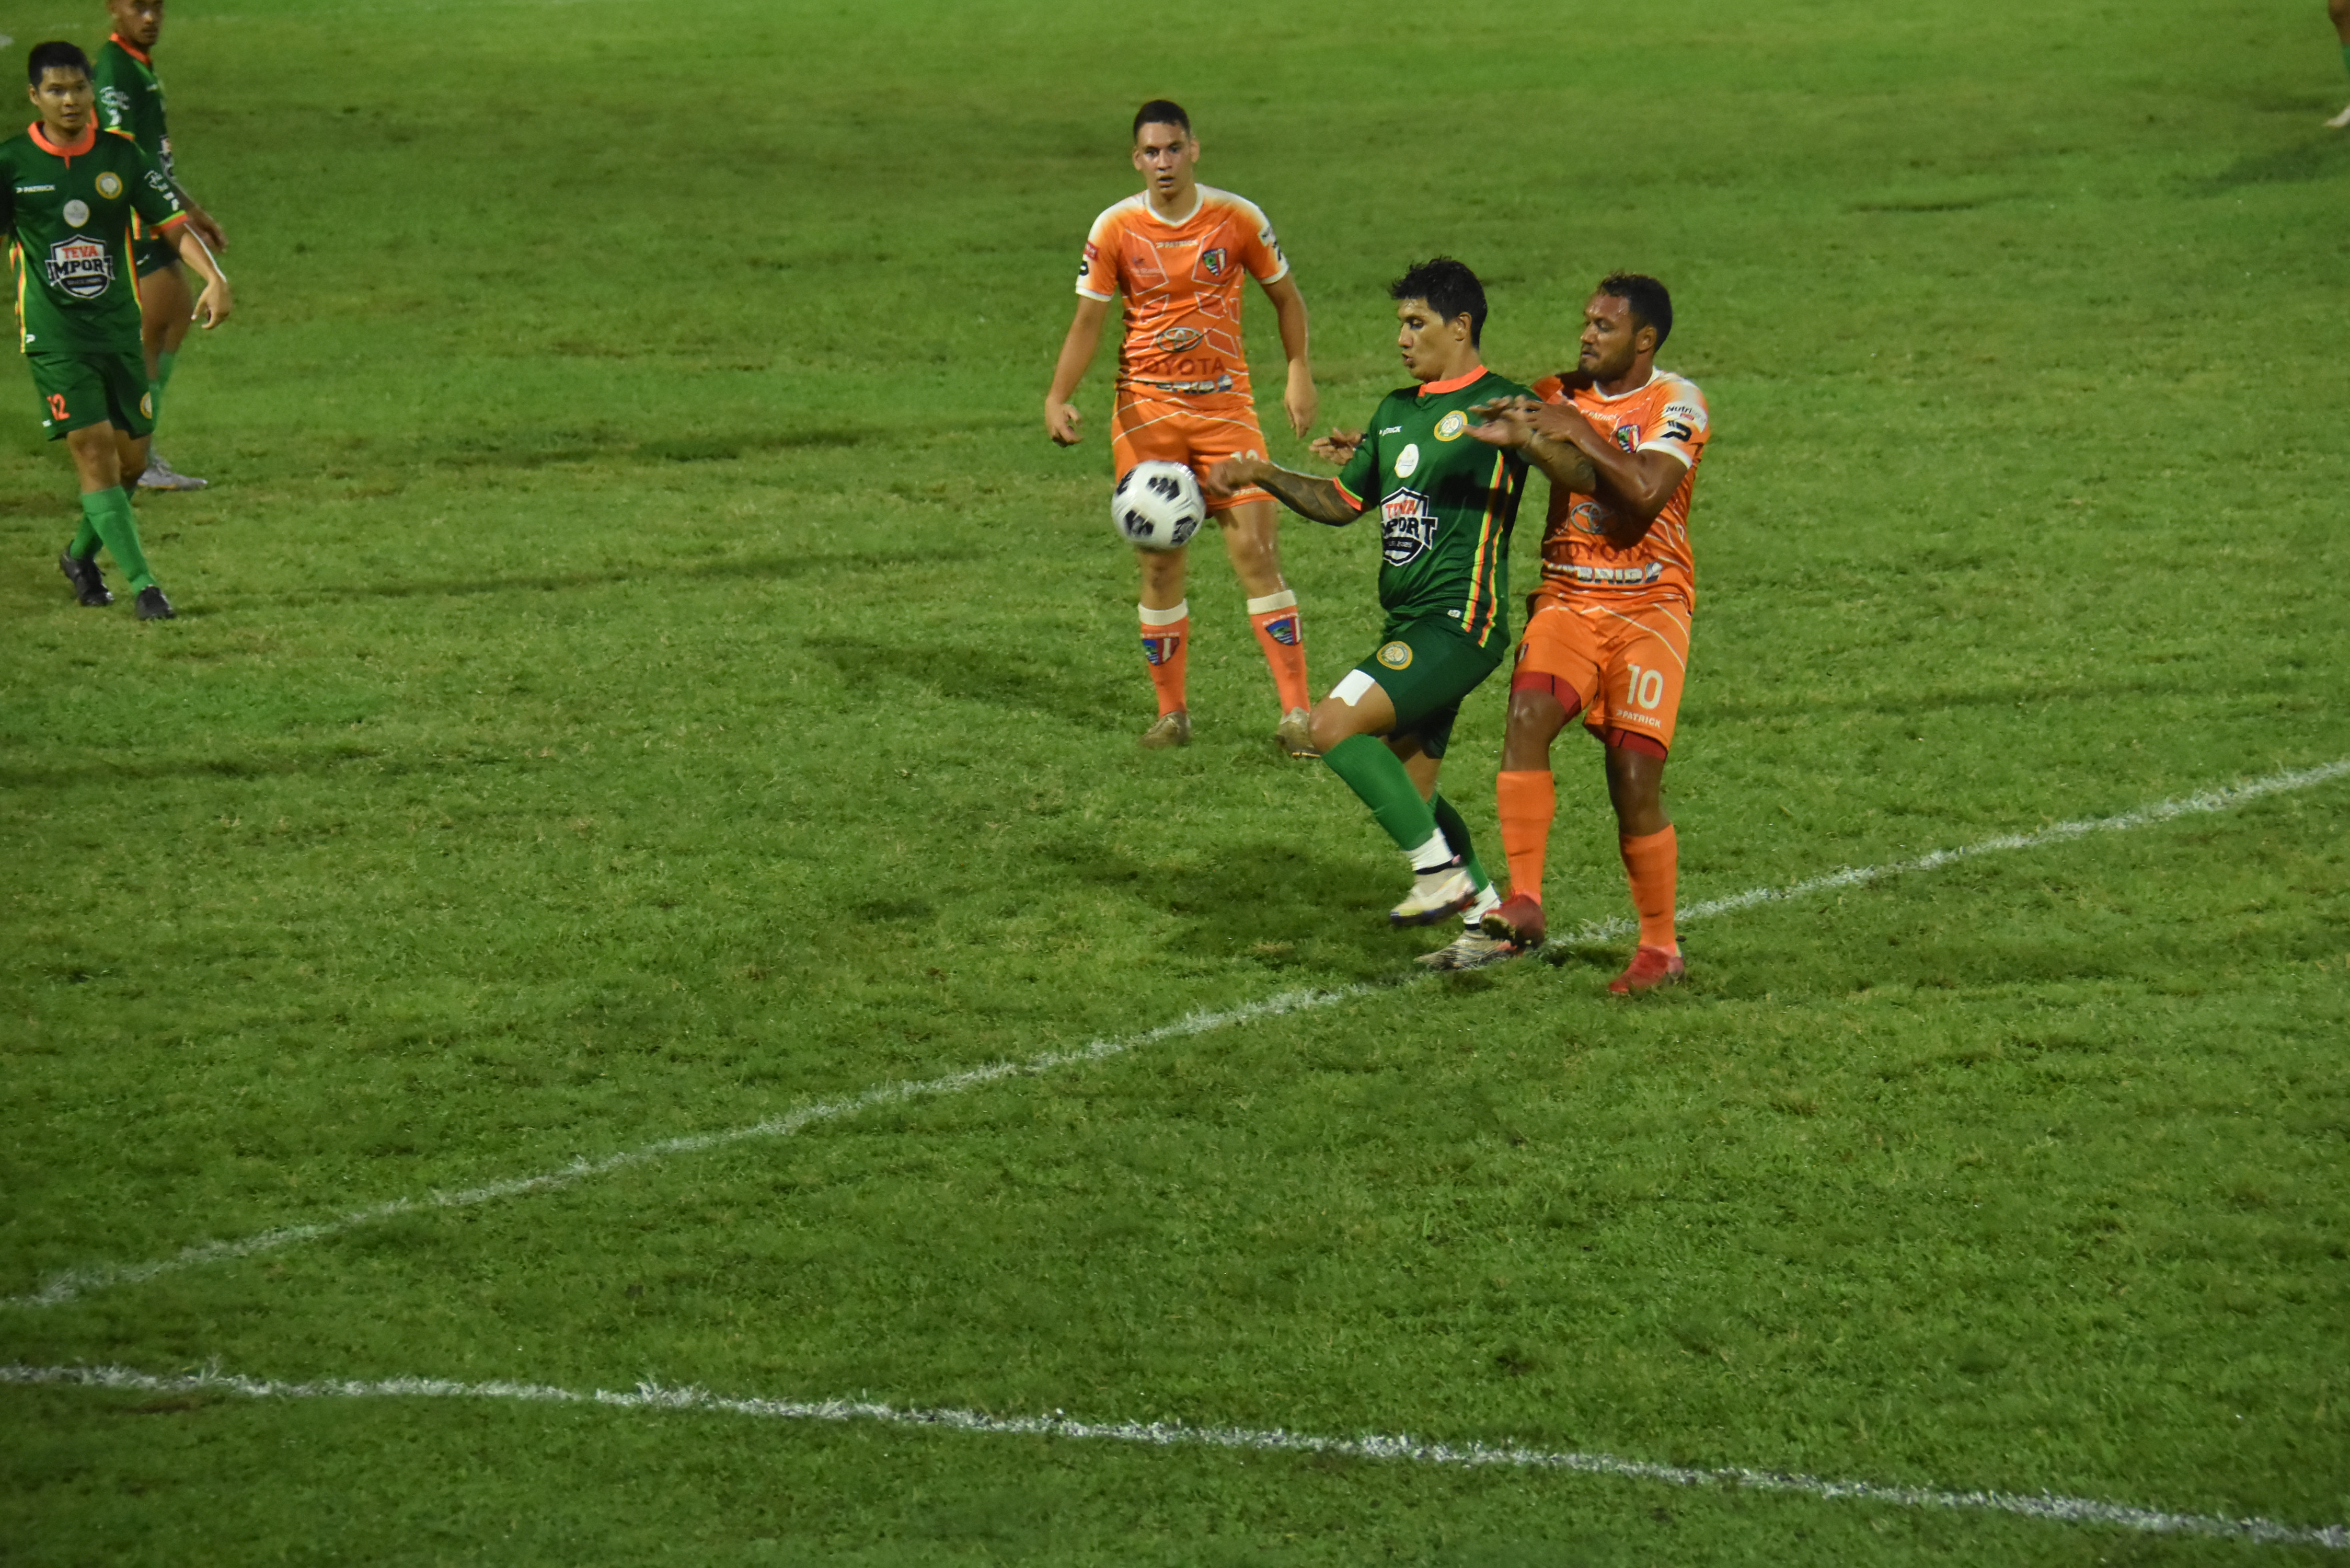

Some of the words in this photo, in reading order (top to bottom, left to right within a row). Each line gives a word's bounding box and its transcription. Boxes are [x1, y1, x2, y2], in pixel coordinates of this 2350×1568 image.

[61, 245, 99, 259] TEVA
[49, 258, 112, 281] IMPORT
[1130, 357, 1225, 375] TOYOTA
[47, 393, 70, 421] 12
[1383, 516, 1436, 545] PORT
[1627, 663, 1663, 709] 10
[1622, 711, 1661, 728] PATRICK
